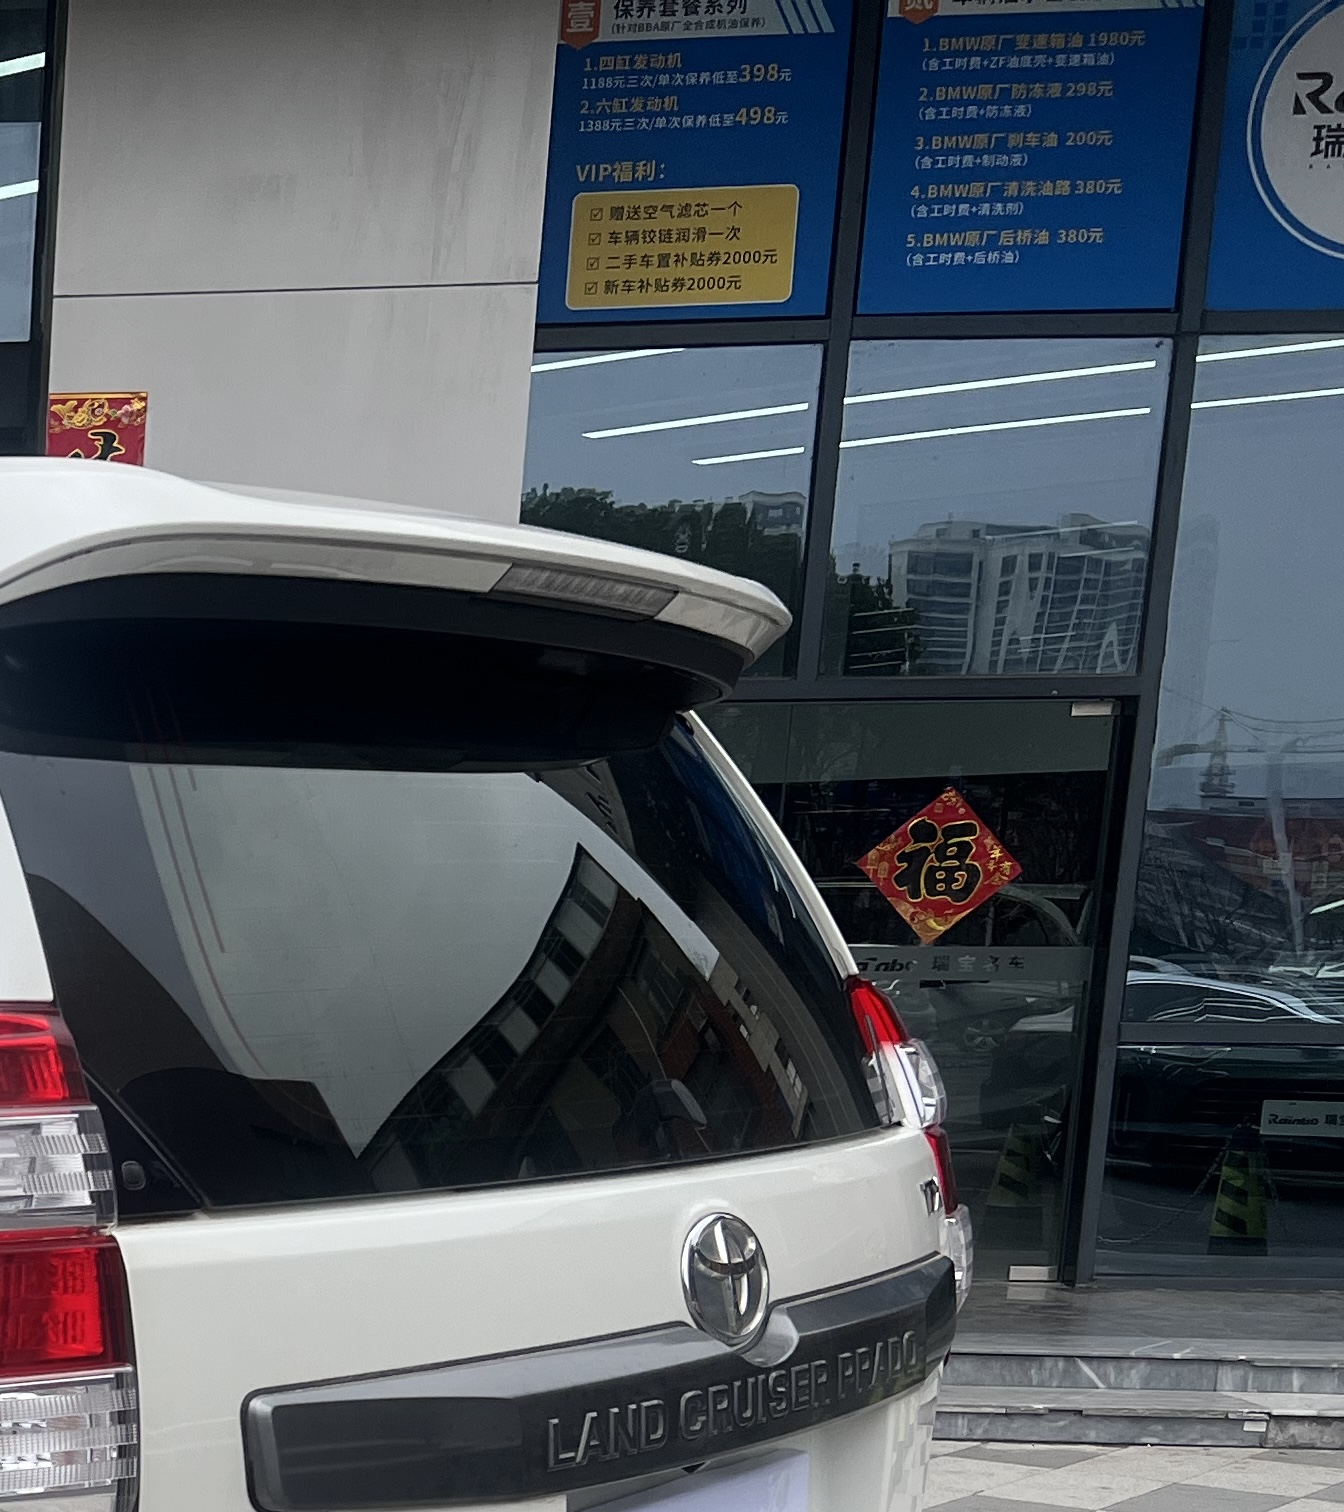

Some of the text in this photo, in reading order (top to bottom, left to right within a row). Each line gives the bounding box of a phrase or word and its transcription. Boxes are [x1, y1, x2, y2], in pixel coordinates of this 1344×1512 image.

[603, 275, 743, 295] 新车补贴券2000元
[893, 816, 982, 905] 福
[931, 954, 1025, 974] 瑞宝名车
[547, 1330, 917, 1473] LAND CRUISER PRADO
